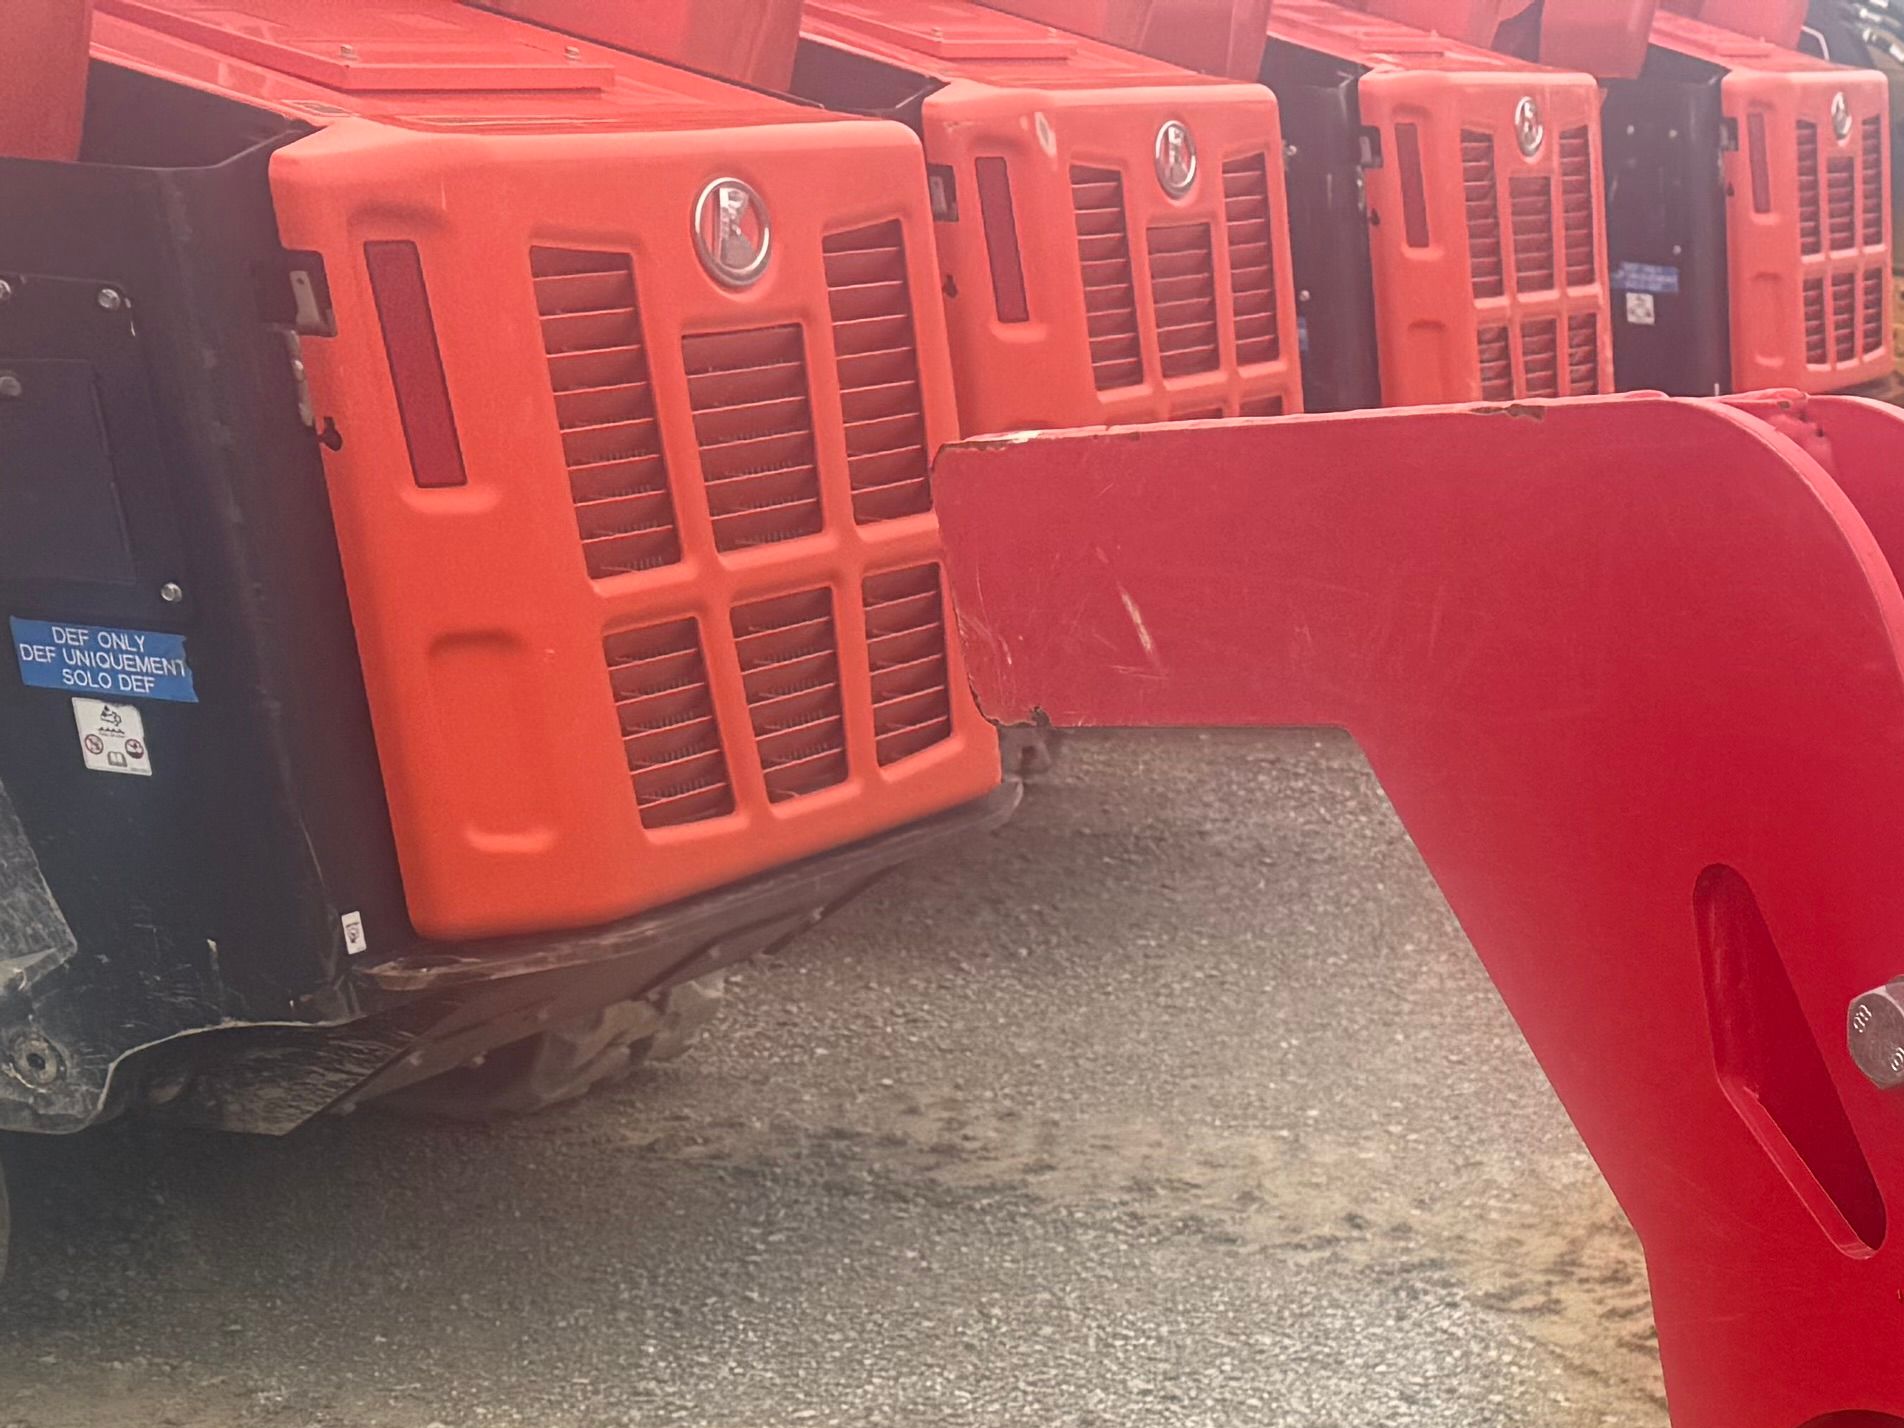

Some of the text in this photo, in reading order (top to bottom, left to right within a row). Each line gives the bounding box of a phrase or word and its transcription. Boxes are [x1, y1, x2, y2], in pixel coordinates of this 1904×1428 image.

[51, 626, 145, 653] DEF ONLY
[19, 643, 186, 677] DEF UNIQUEMENT
[62, 668, 156, 693] SOLO DEF
